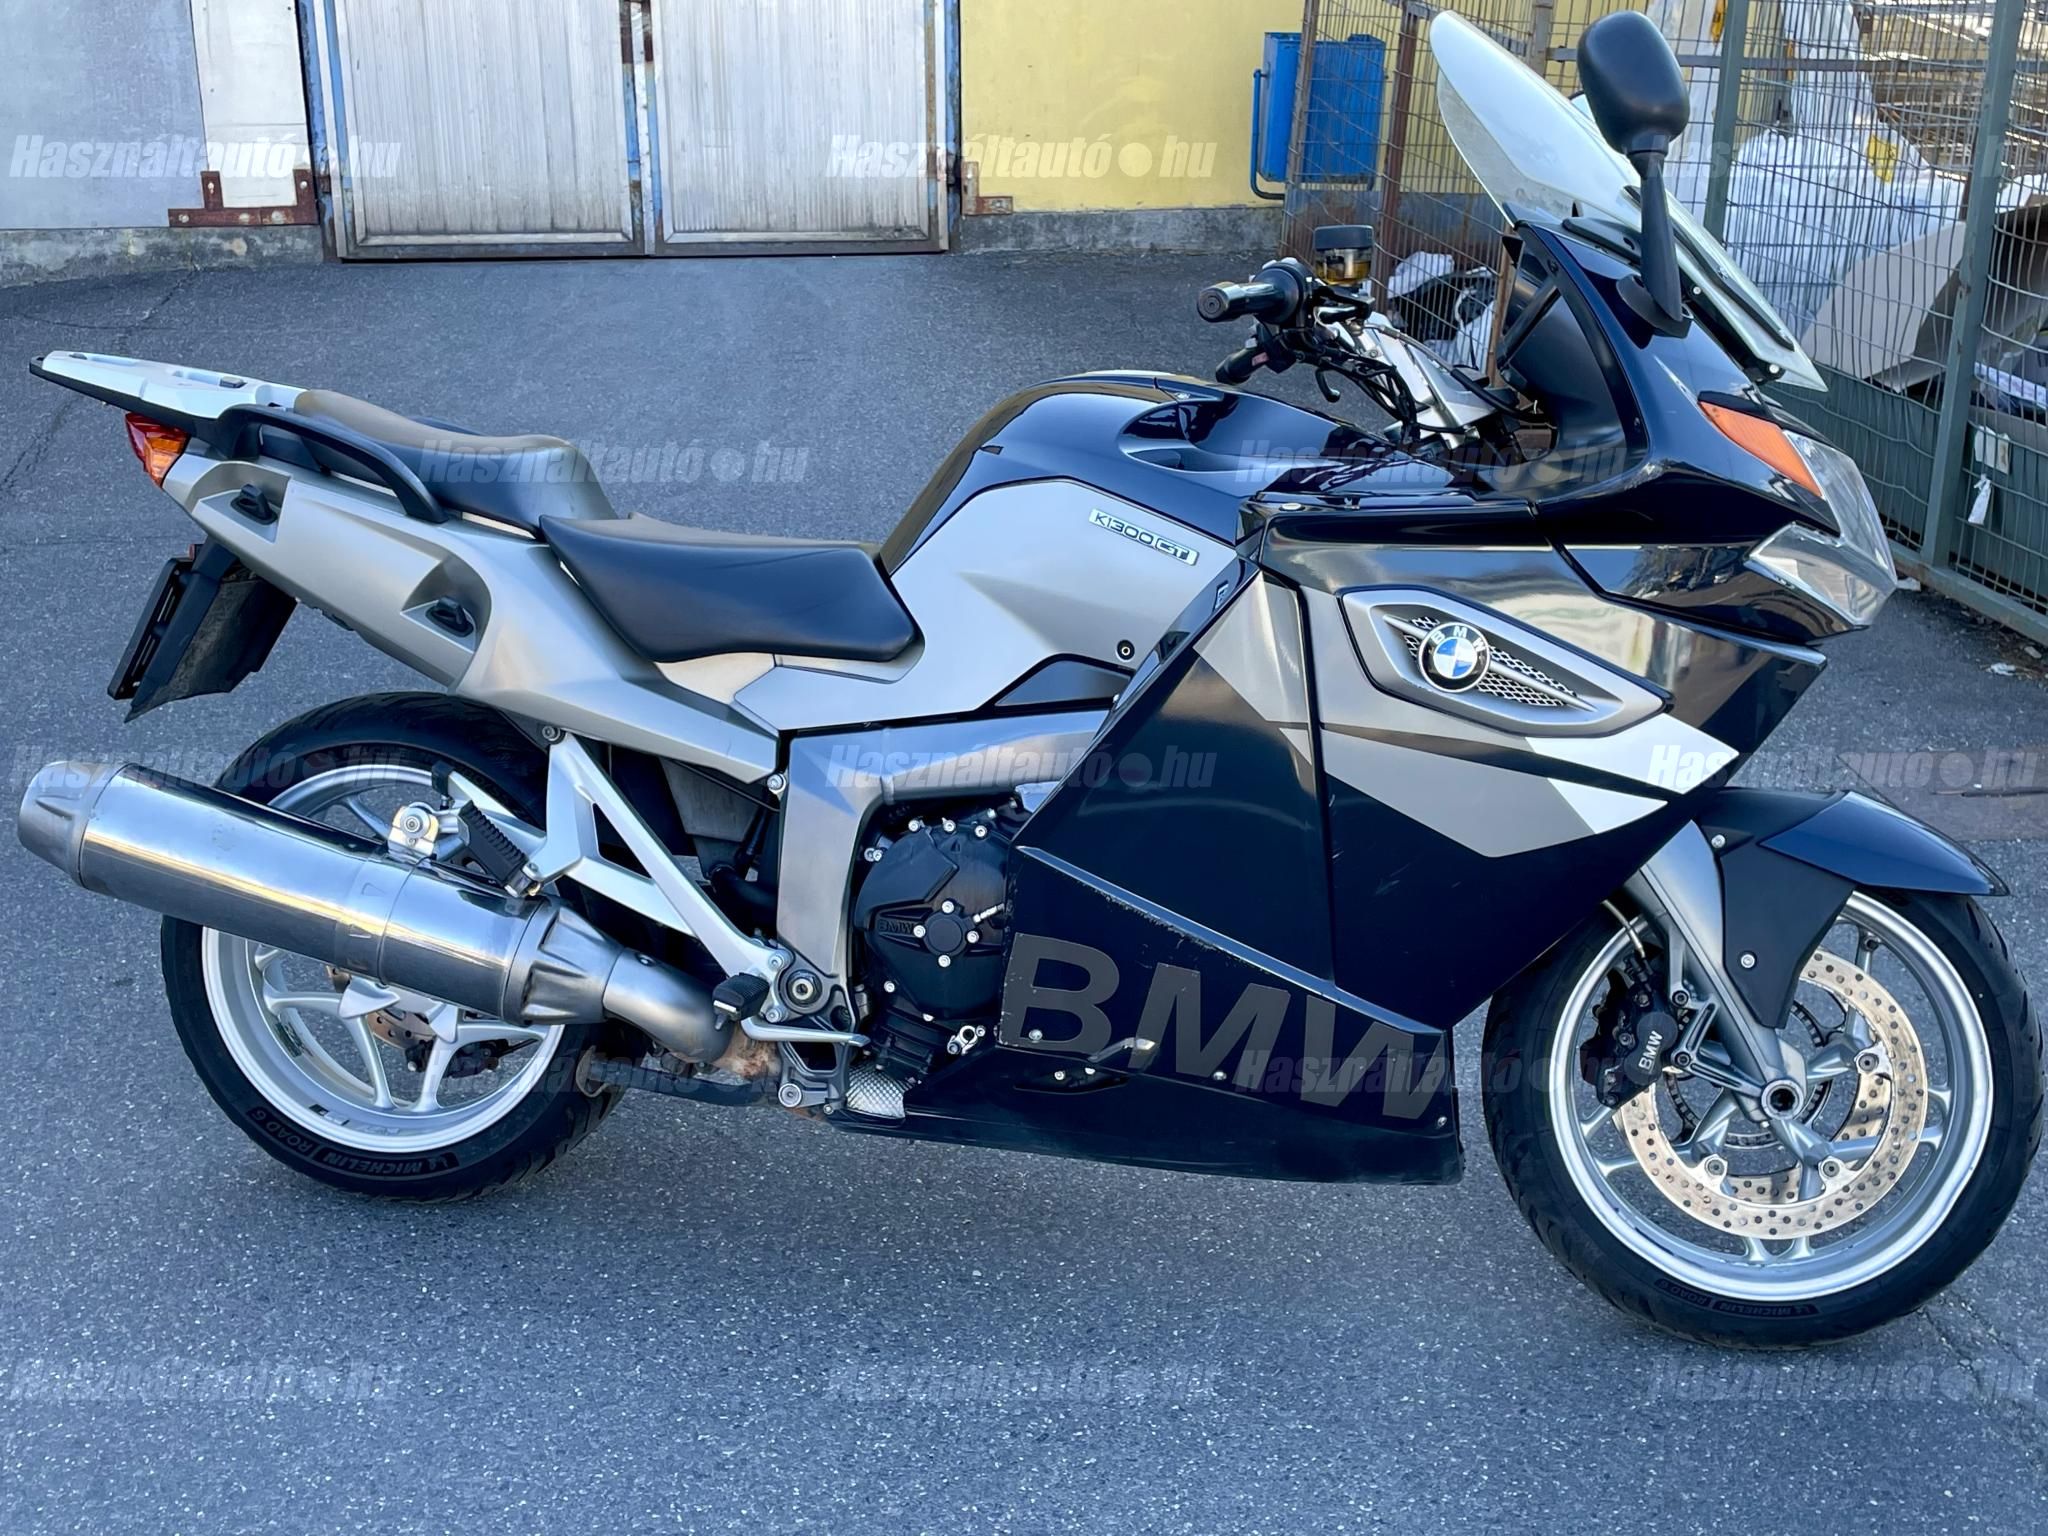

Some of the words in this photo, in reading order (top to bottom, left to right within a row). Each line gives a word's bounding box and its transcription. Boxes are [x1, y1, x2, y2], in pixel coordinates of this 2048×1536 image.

[1430, 625, 1486, 653] BMW
[879, 920, 915, 934] BMW
[999, 931, 1443, 1121] BMW
[1638, 1030, 1663, 1070] BMW
[265, 1119, 316, 1152] ROAD
[323, 1150, 423, 1176] MICHELIN
[1720, 1301, 1792, 1316] MICHELIN
